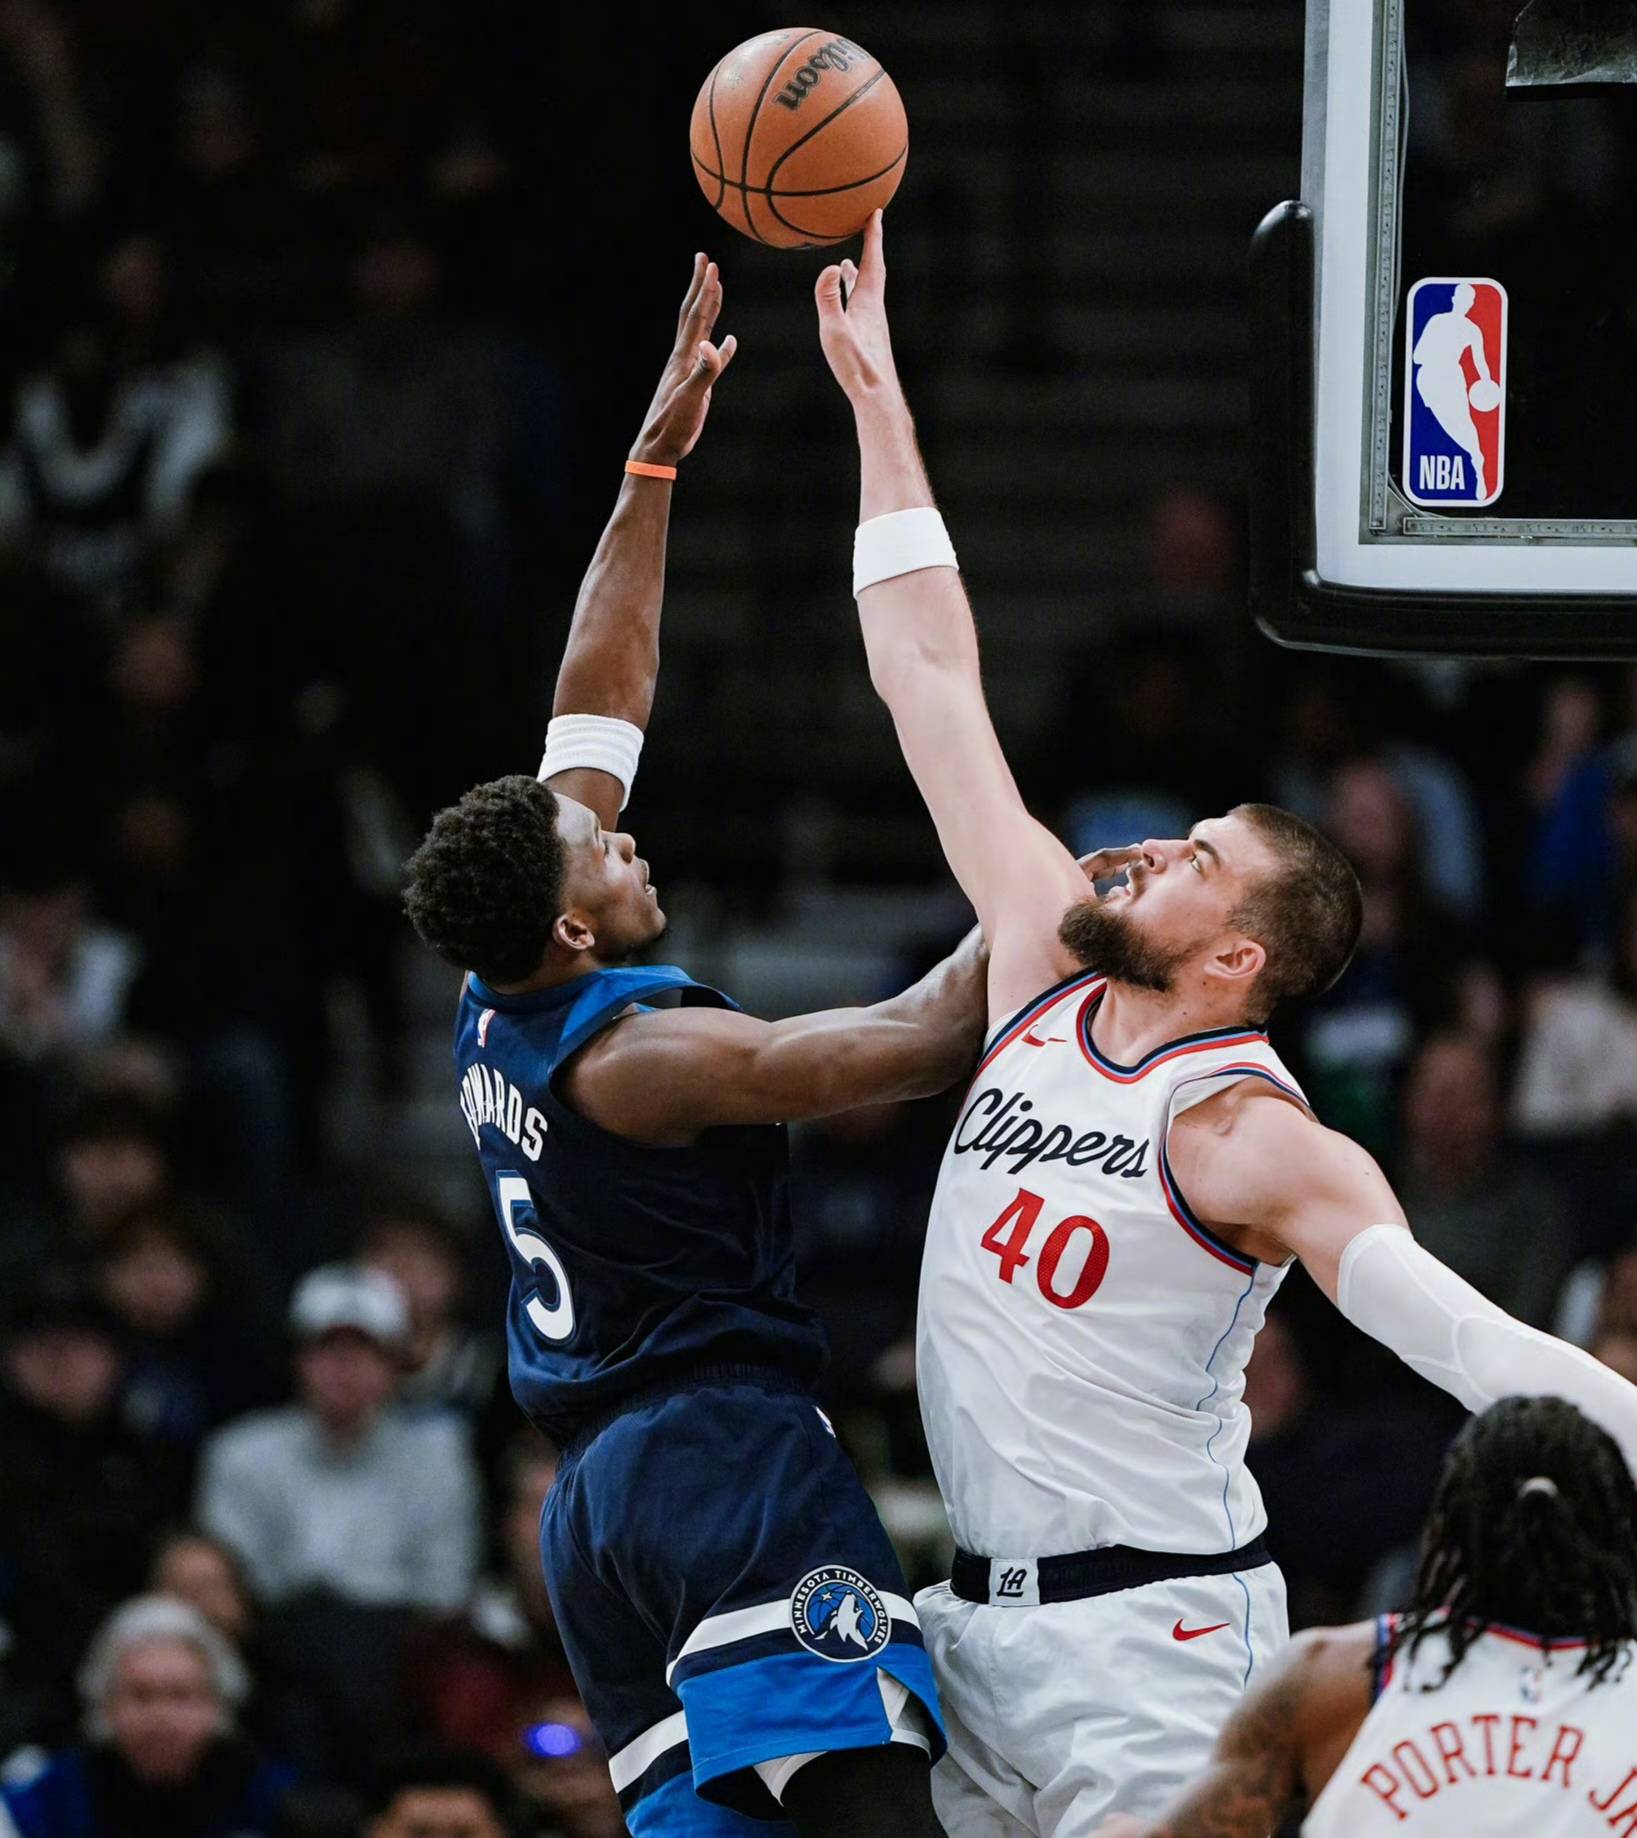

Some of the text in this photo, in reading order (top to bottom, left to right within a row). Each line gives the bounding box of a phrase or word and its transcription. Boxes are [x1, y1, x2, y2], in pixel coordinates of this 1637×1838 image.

[1419, 455, 1466, 490] NBA
[954, 1088, 1150, 1178] Clippers
[496, 1170, 576, 1344] 5
[980, 1187, 1110, 1310] 40
[794, 1571, 888, 1644] MINNESOTA TIMBERWOLVES
[996, 1567, 1028, 1598] LA
[1361, 1714, 1585, 1821] PORTER
